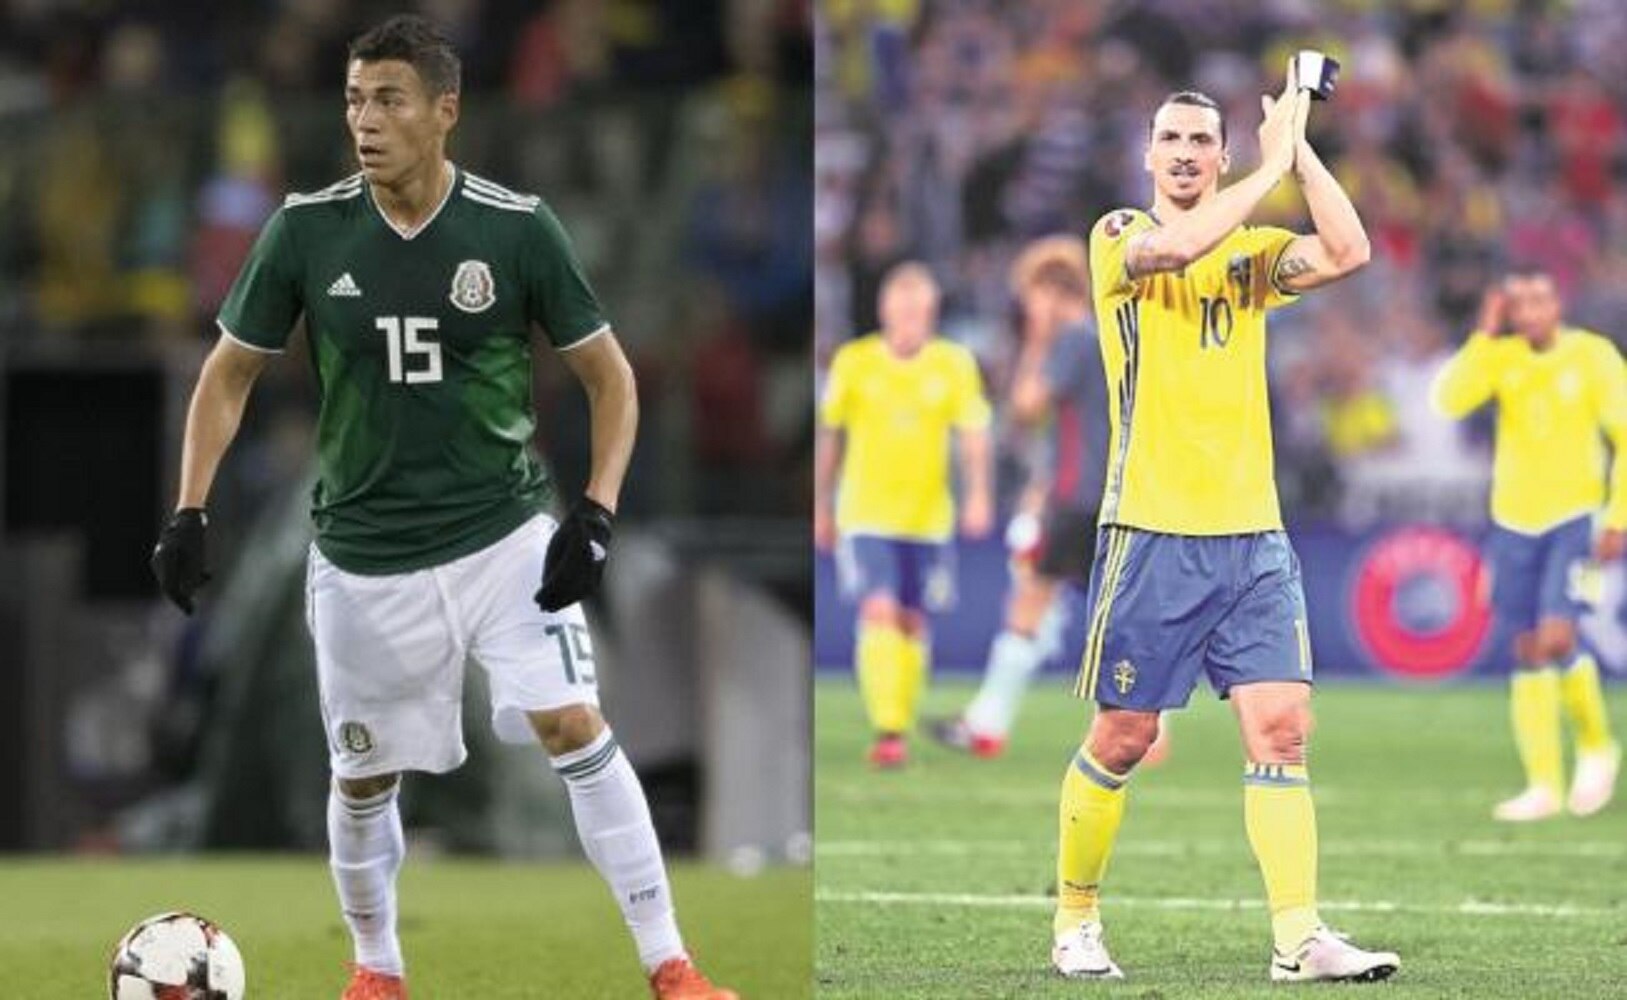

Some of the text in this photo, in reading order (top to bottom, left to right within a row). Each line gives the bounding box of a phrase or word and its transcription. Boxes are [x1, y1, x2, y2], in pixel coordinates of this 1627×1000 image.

[374, 315, 443, 384] 15
[1199, 295, 1233, 350] 10
[543, 622, 596, 685] 15
